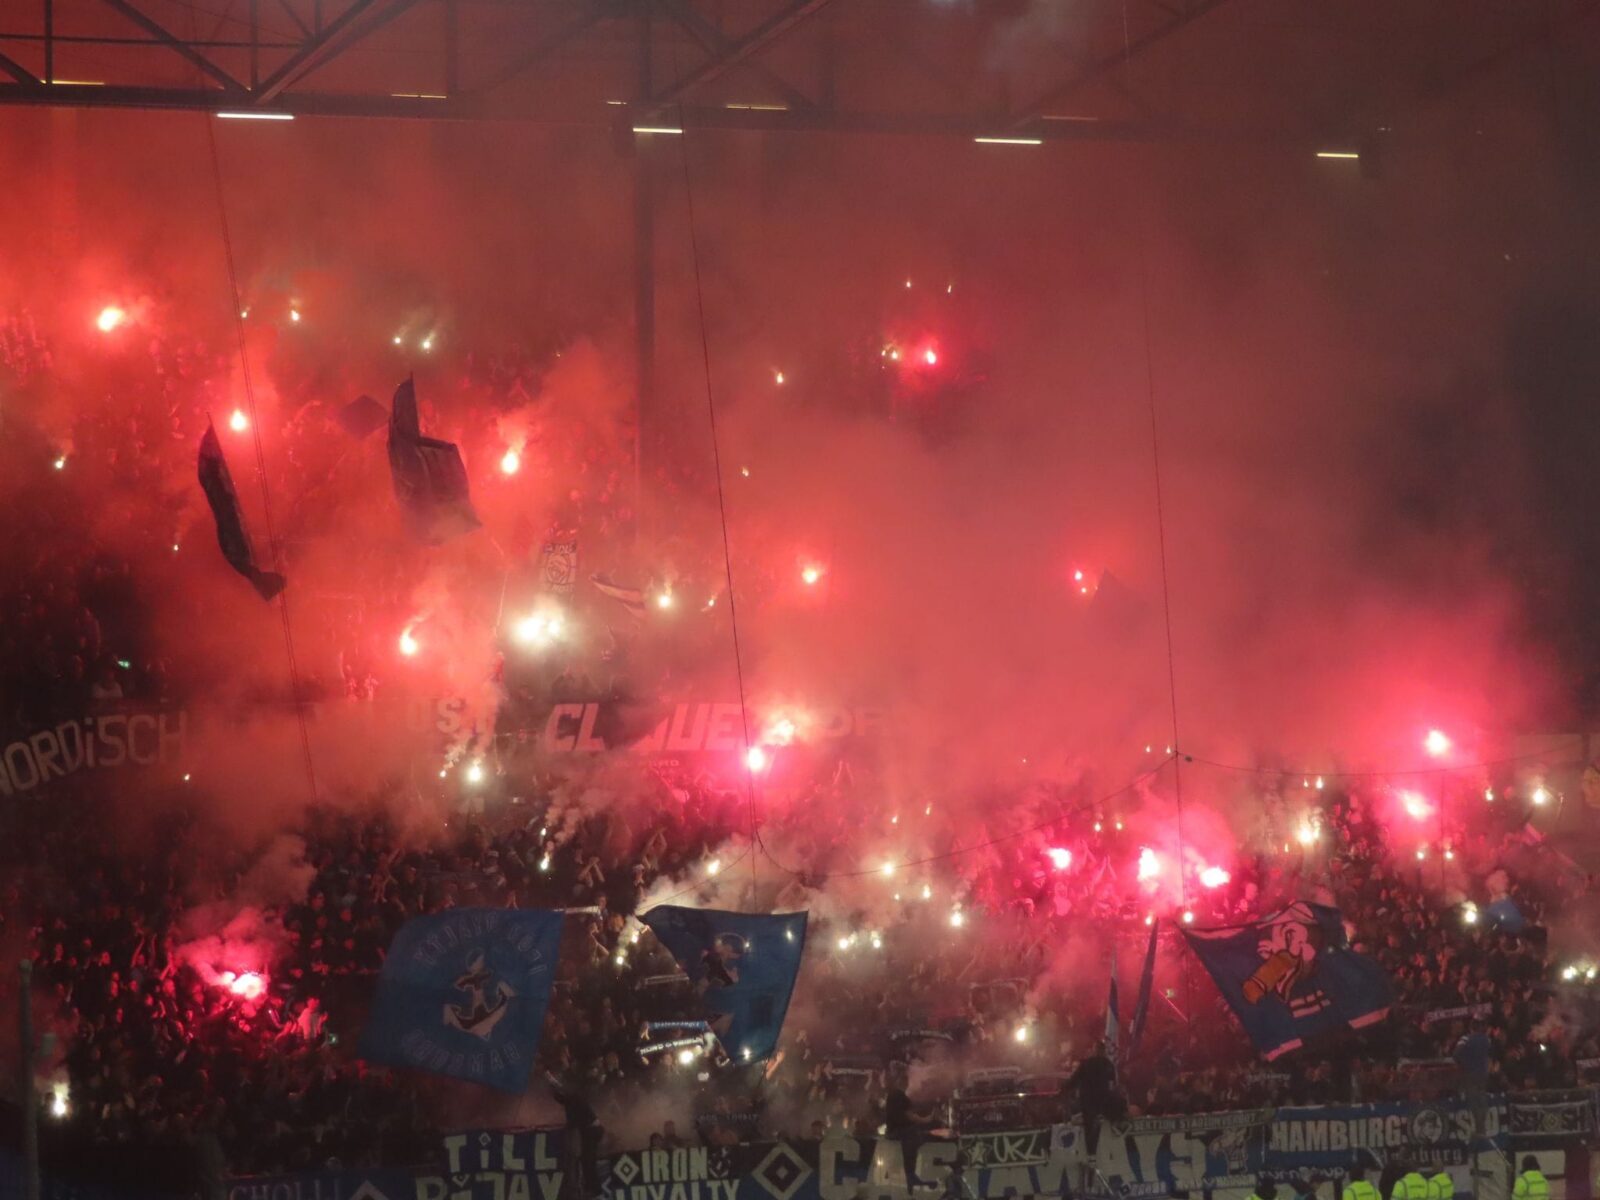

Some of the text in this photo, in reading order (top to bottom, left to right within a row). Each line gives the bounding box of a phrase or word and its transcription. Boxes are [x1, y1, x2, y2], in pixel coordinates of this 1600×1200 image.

[544, 703, 746, 751] CLUE
[1269, 1114, 1402, 1152] HAMBURG
[641, 1147, 708, 1184] IRON
